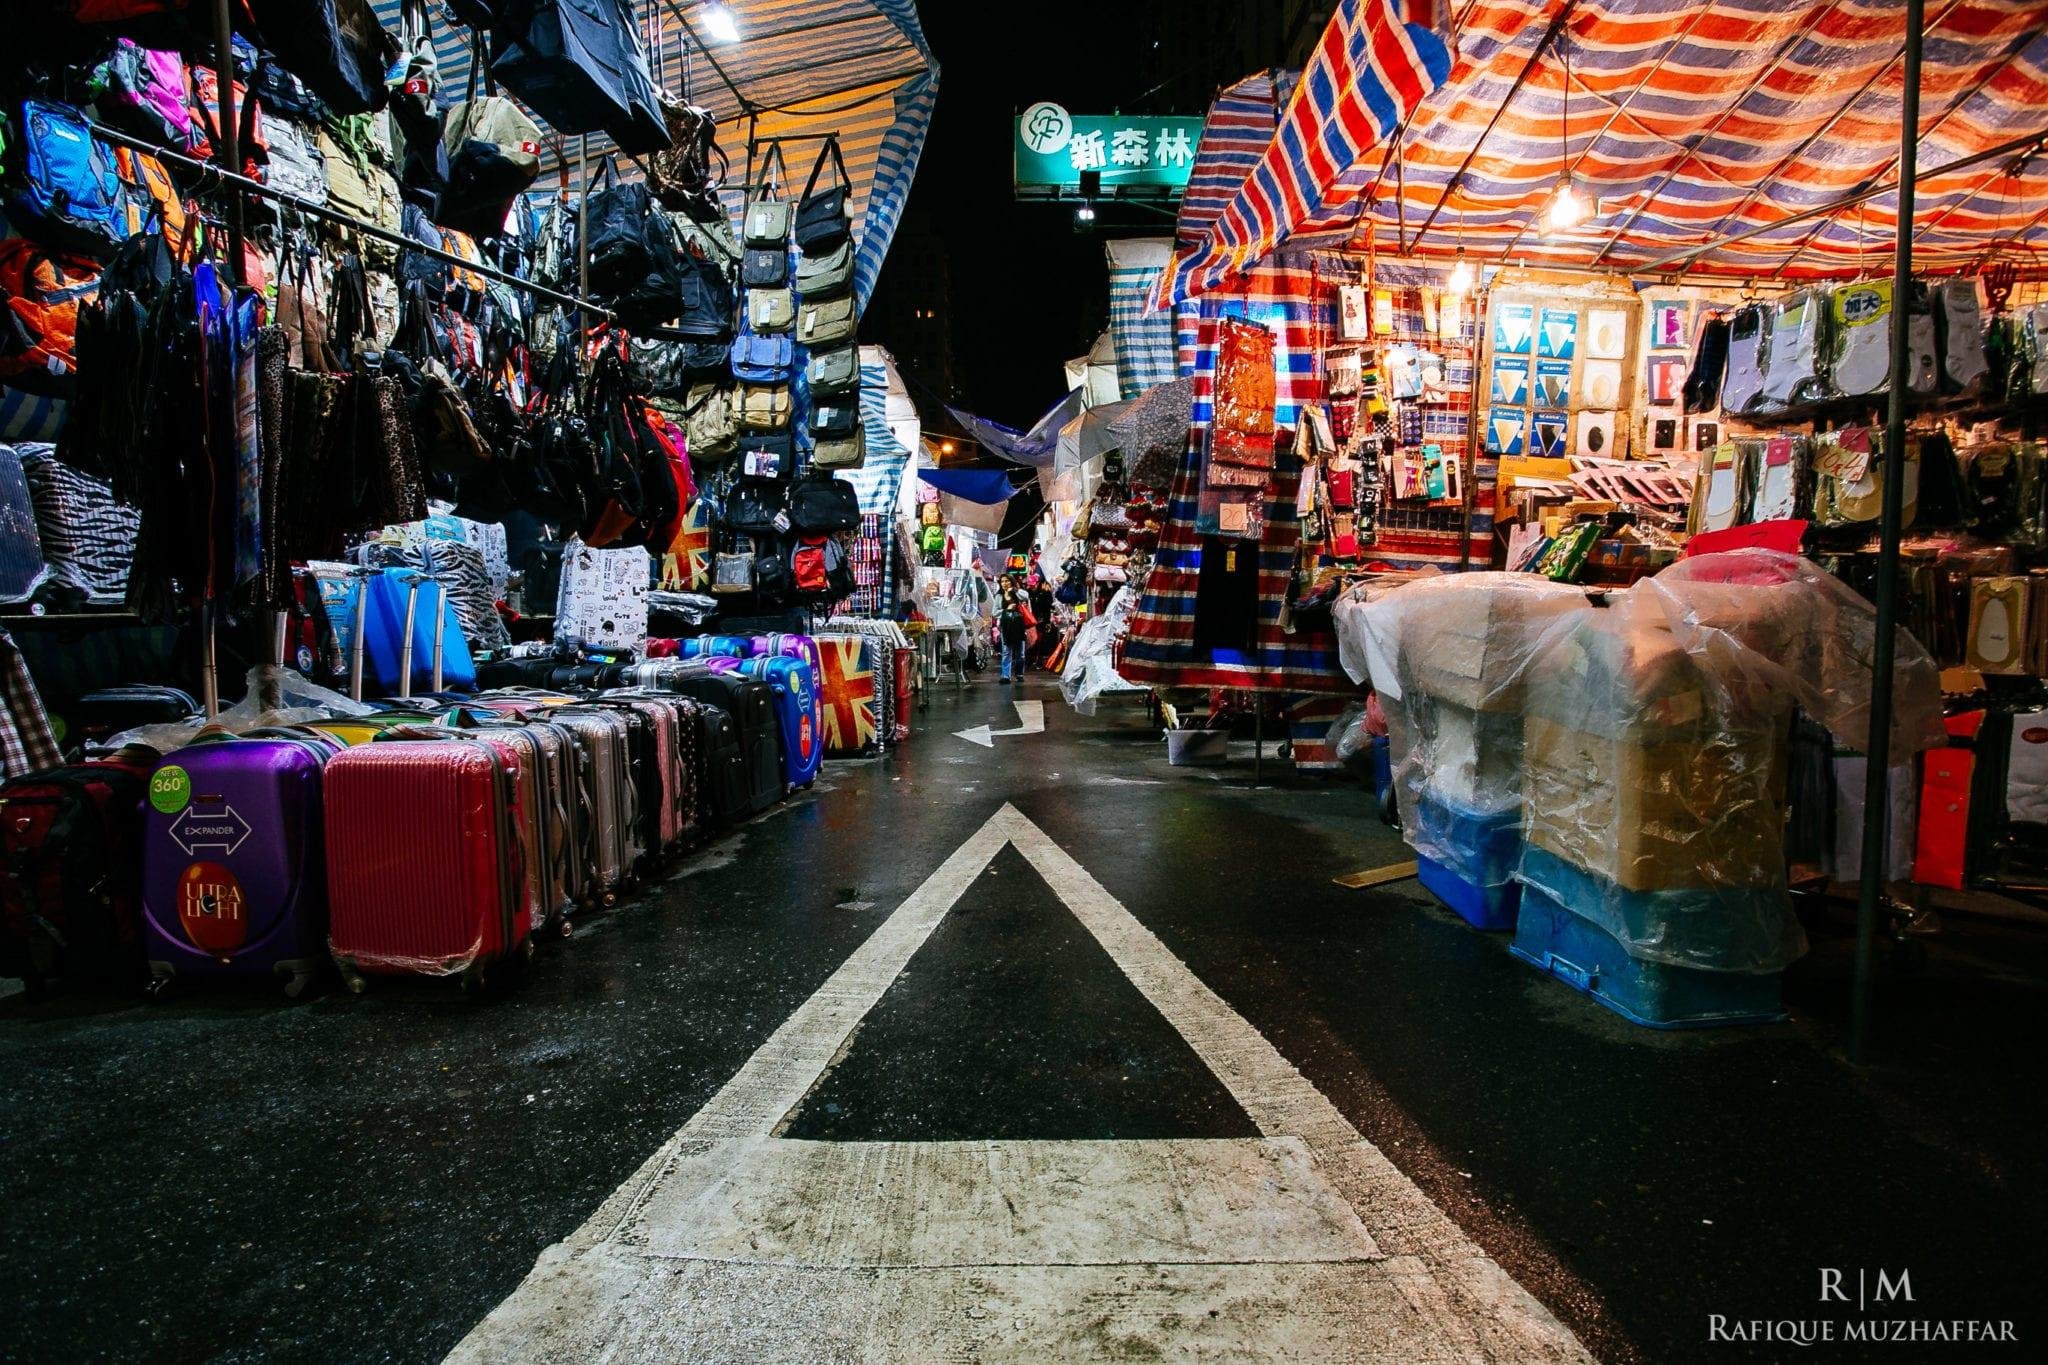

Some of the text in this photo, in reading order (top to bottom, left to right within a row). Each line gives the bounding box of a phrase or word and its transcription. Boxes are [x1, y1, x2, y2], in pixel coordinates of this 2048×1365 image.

[1069, 130, 1194, 170] 新森林
[1845, 295, 1879, 314] 加大
